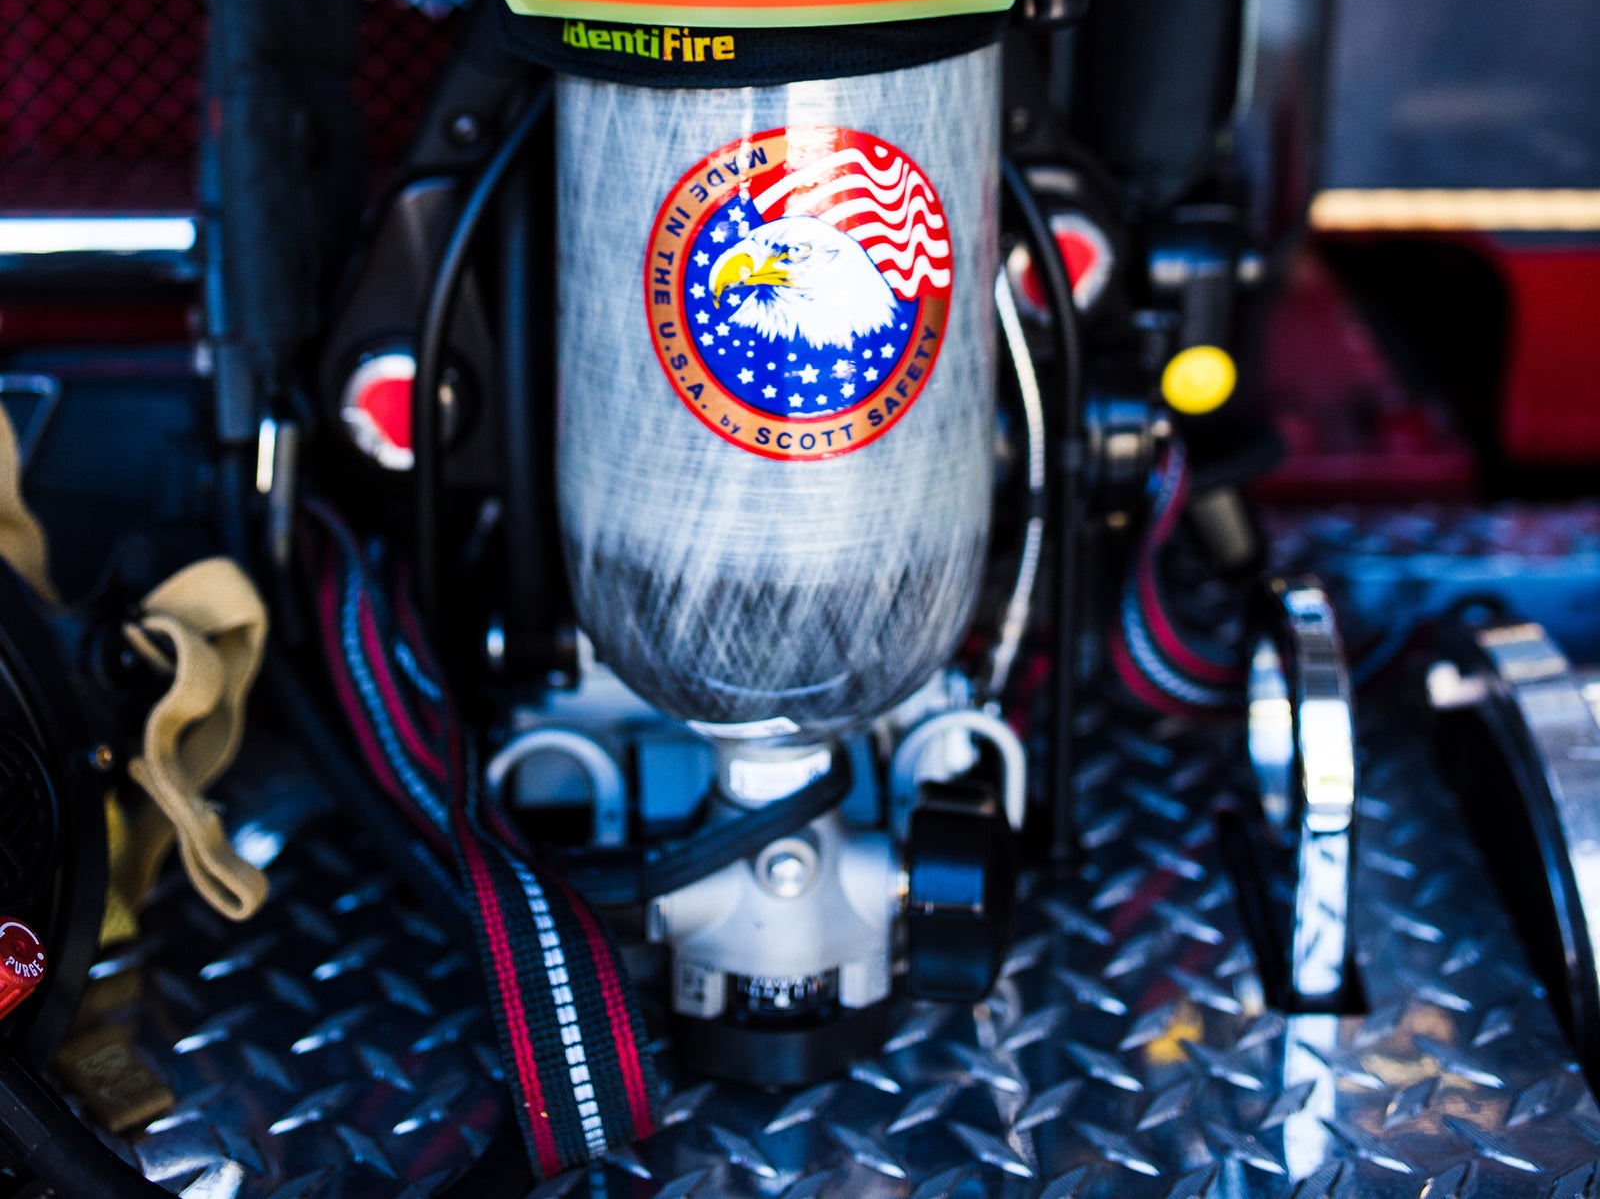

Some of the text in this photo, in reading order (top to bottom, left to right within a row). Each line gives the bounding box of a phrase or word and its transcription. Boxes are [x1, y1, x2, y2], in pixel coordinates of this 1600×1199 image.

[689, 146, 768, 203] MADE
[665, 205, 691, 237] IN
[653, 250, 675, 306] THE
[866, 325, 938, 428] SAFETY
[719, 414, 741, 435] by
[754, 423, 854, 451] SCOTT
[5, 955, 44, 978] PURGE
